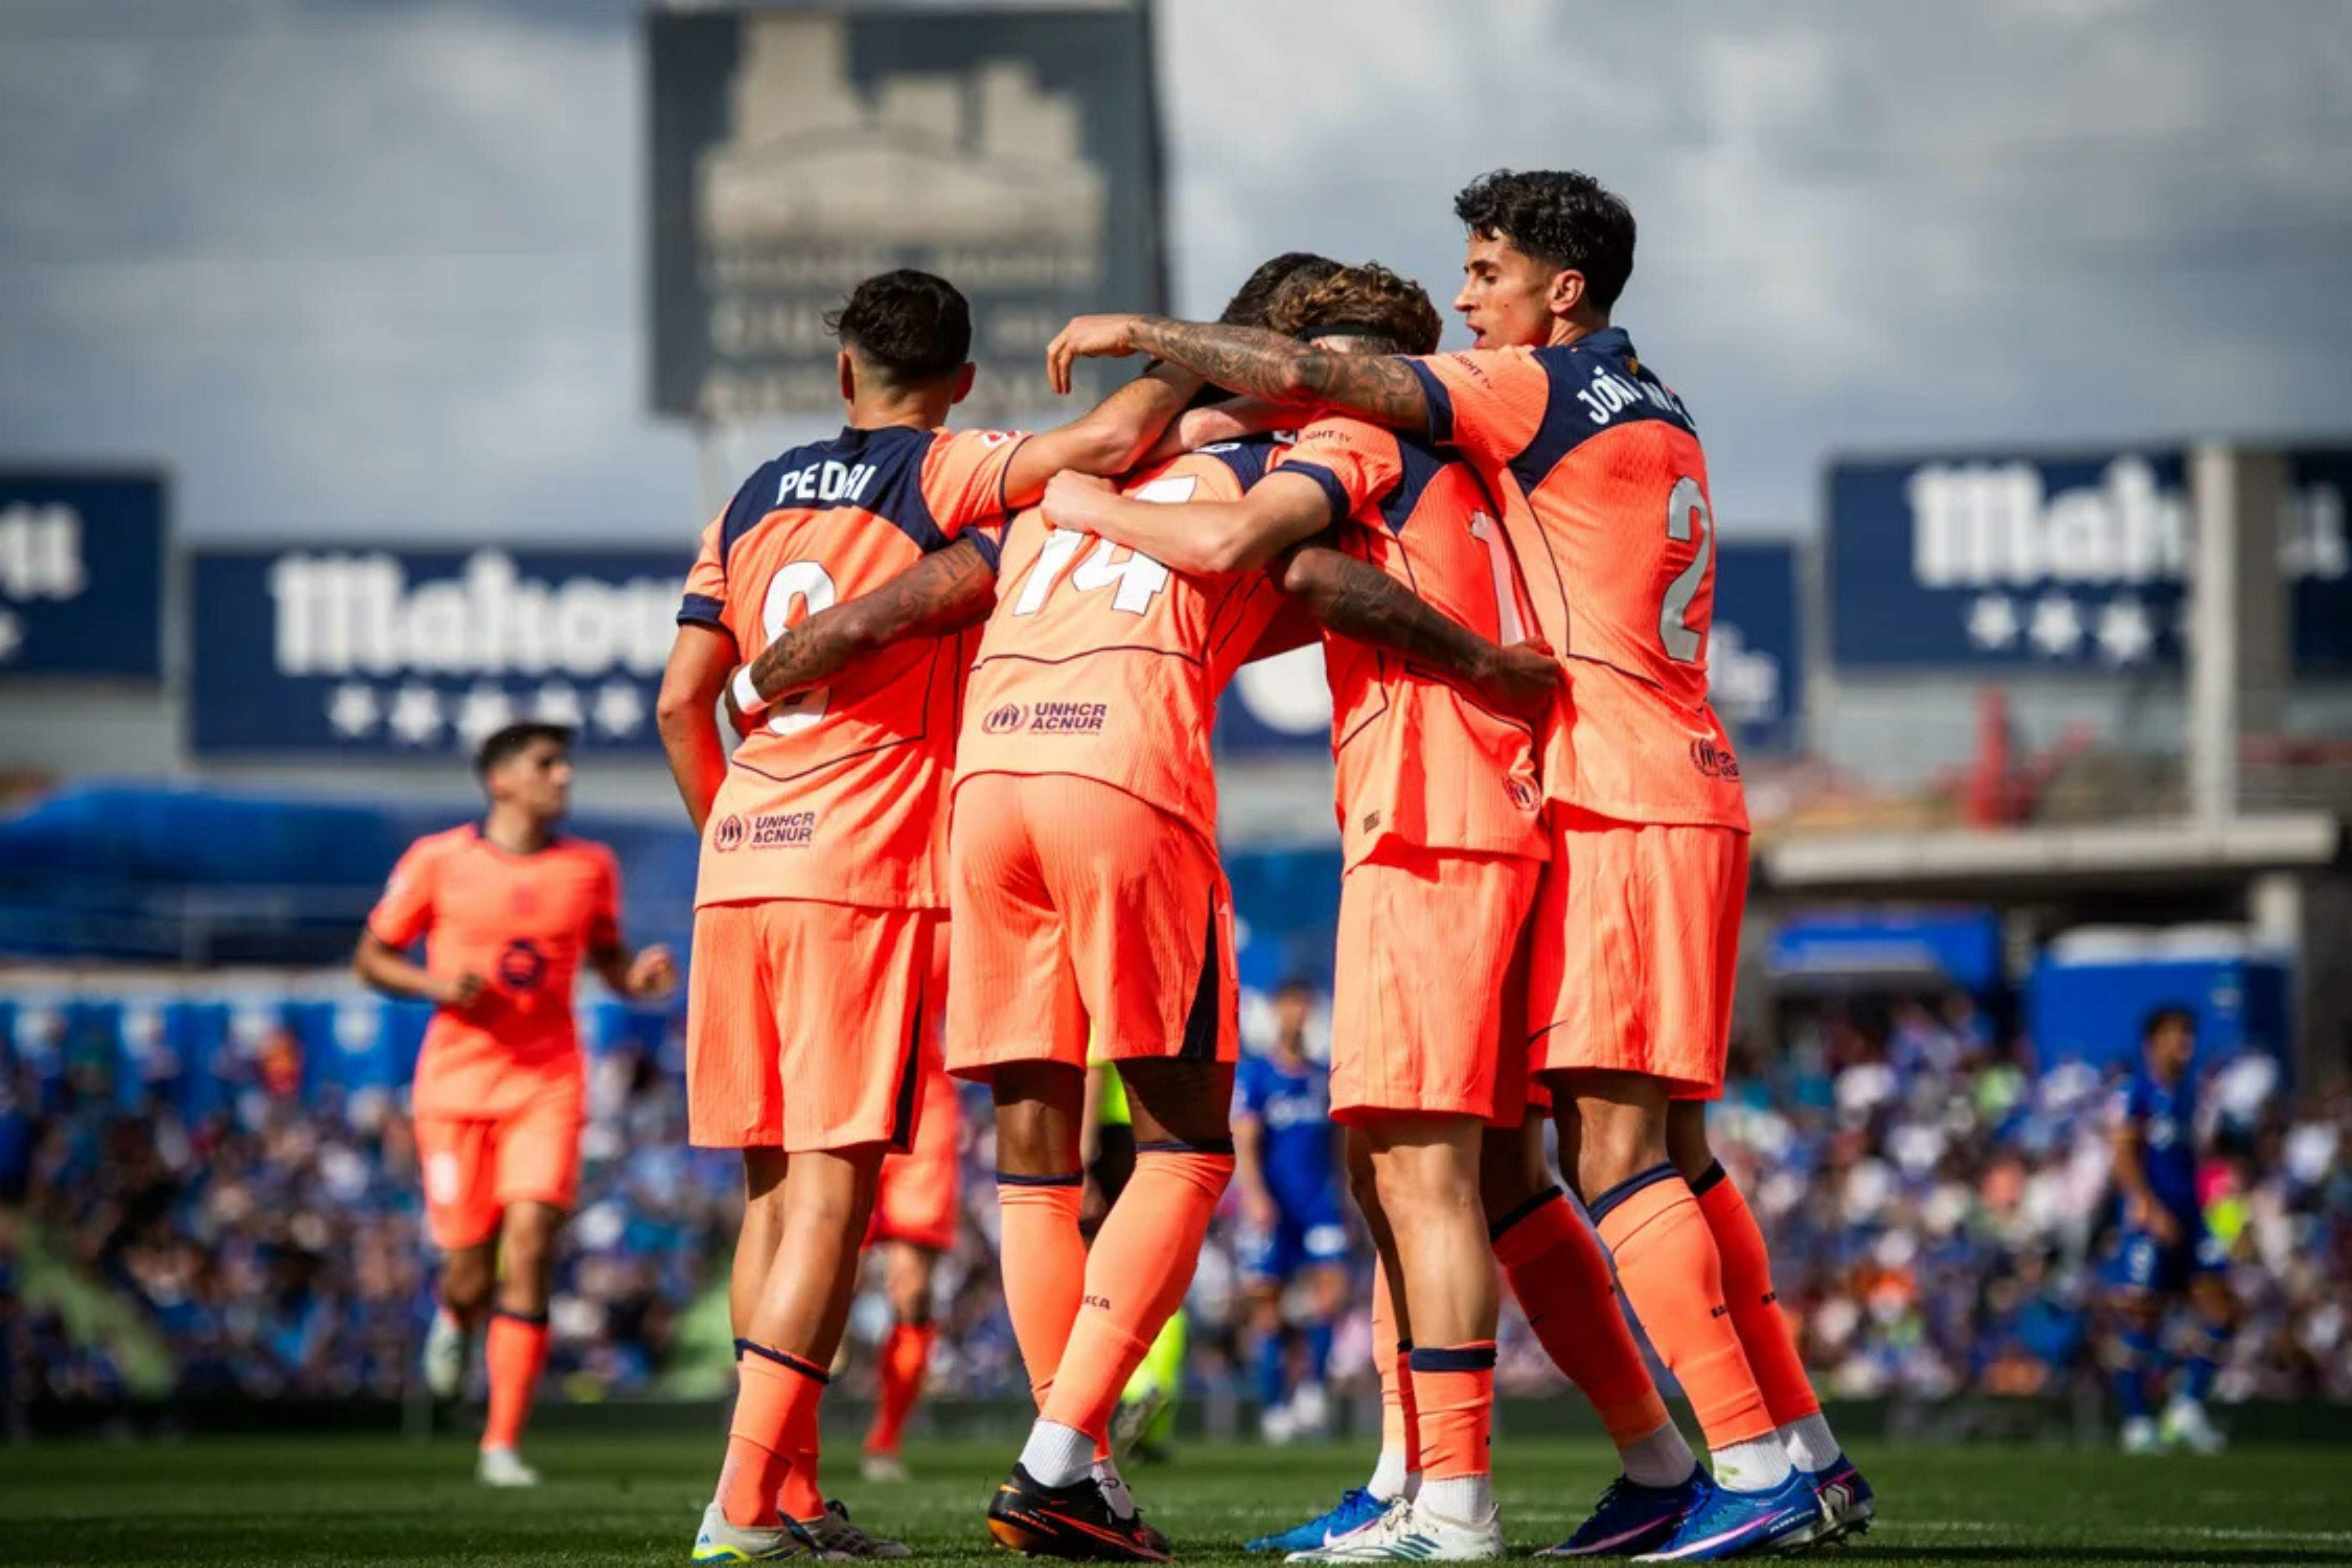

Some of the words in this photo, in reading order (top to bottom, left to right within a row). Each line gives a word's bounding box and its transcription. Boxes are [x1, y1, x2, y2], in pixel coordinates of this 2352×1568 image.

[777, 460, 877, 505] PEDRI
[1013, 474, 1197, 617] 14
[1469, 510, 1537, 646] 1
[1661, 475, 1711, 664] 2
[1031, 717, 1104, 730] ACNUR
[1034, 702, 1107, 717] UNHCR
[753, 828, 813, 843] ACNUR
[755, 811, 815, 829] UNHCR
